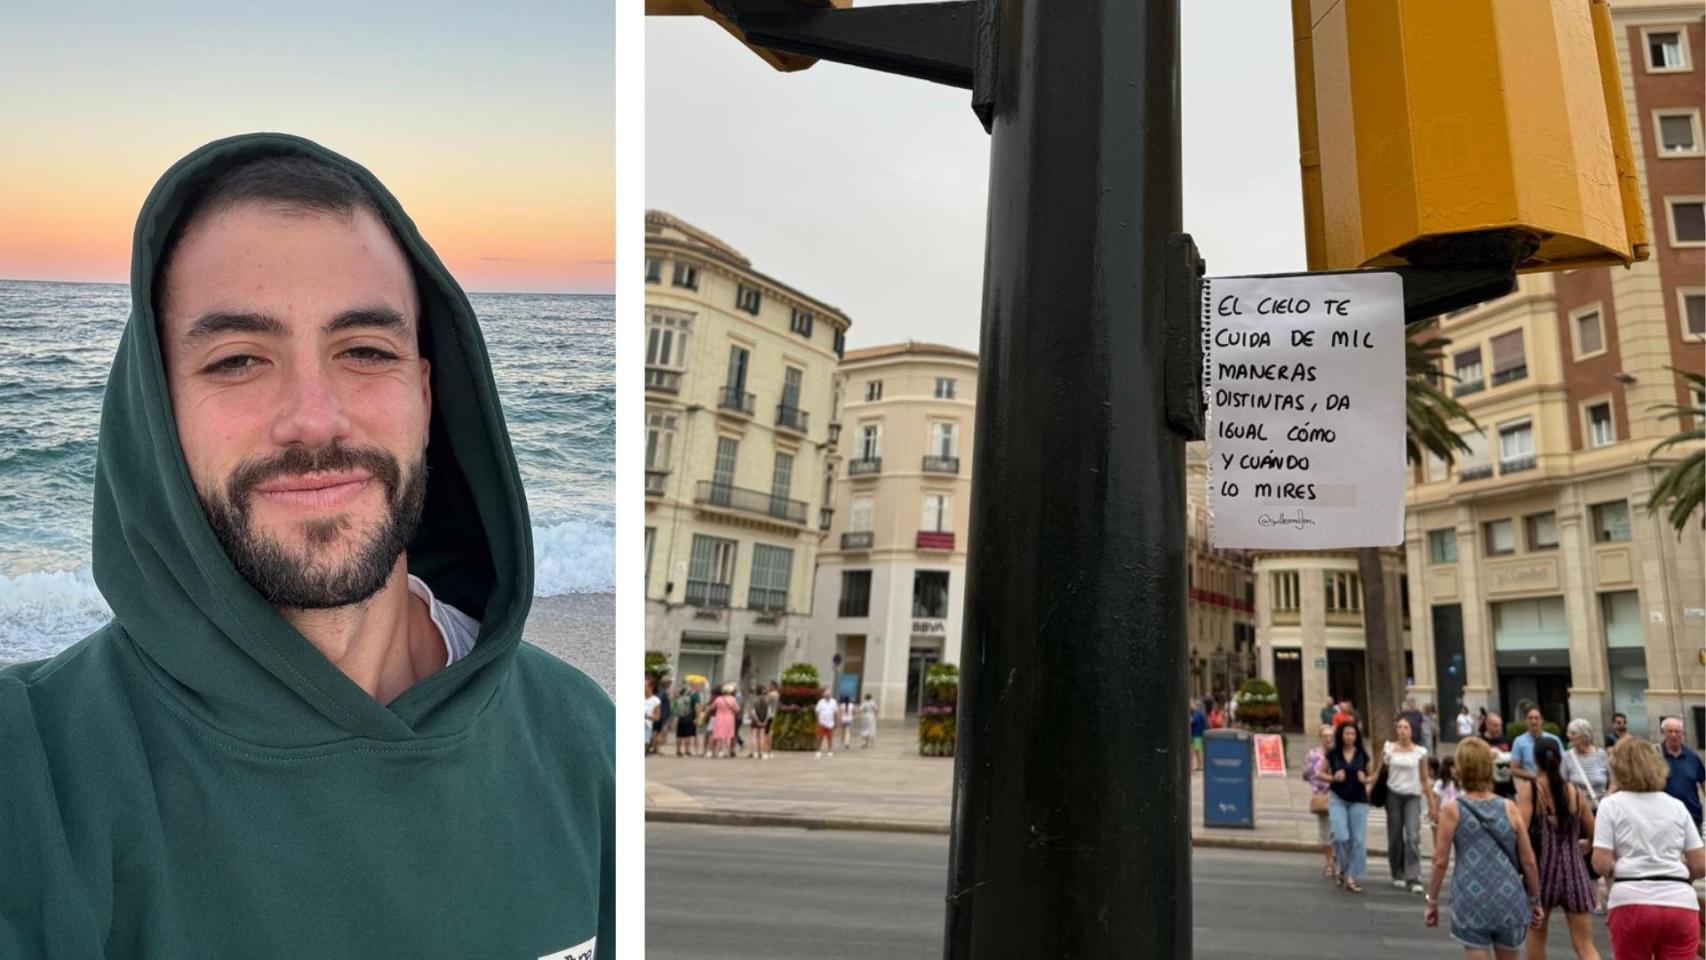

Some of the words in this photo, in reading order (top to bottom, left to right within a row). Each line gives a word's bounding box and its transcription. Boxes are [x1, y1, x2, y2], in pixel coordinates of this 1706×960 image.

[1217, 294, 1243, 316] EL
[1257, 297, 1311, 315] CIELO
[1323, 299, 1351, 316] TE
[1214, 328, 1271, 348] CUIDA
[1291, 329, 1316, 348] DE
[1218, 362, 1317, 383] MANERAS
[1325, 393, 1351, 411] DA
[1218, 420, 1268, 442] IGUAL
[1286, 421, 1336, 444] CÓMO
[1221, 453, 1235, 471] Y
[1239, 449, 1310, 471] CUÁNDO
[1221, 480, 1239, 498] LO
[1254, 483, 1317, 501] MIRES
